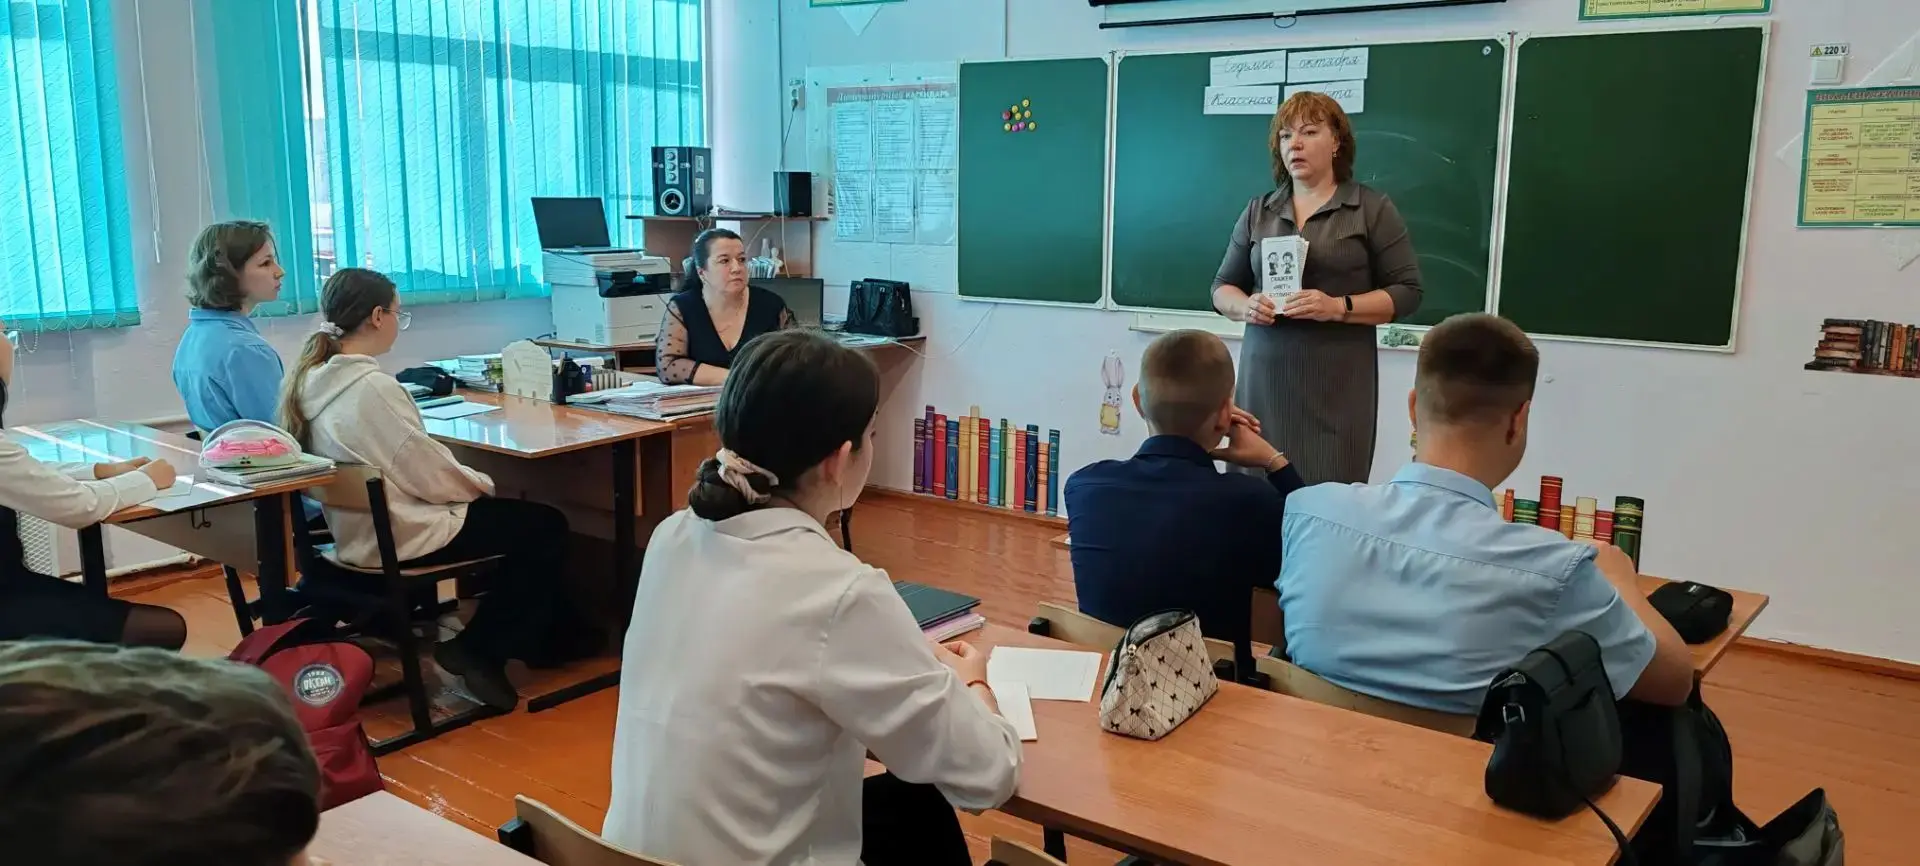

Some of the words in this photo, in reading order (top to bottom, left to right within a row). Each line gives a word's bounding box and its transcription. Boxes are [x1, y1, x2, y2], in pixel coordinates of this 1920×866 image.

[1824, 46, 1839, 55] 220
[1841, 45, 1847, 54] V
[1225, 58, 1274, 79] Седьмое
[1300, 49, 1359, 71] октября
[1211, 93, 1273, 105] Классная
